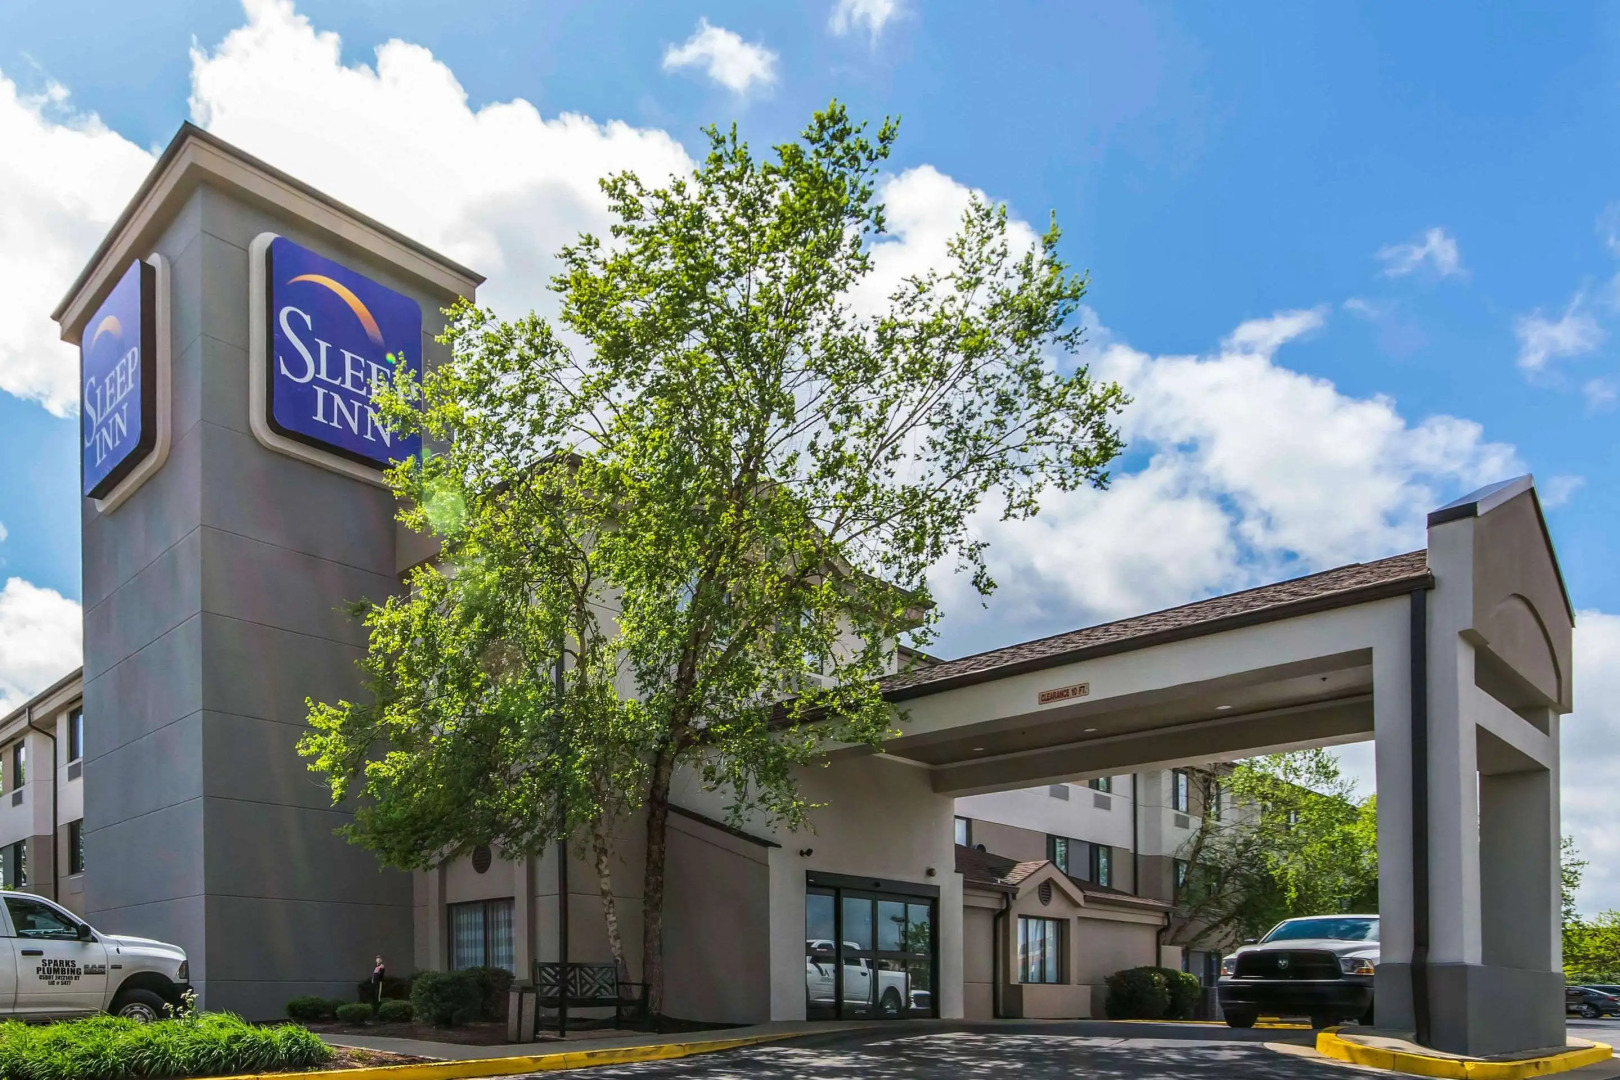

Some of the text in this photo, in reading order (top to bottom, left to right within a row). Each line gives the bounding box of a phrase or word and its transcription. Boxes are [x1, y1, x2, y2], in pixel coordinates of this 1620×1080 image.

[279, 305, 420, 402] SLEE
[84, 346, 138, 449] SLEEP
[312, 386, 399, 448] INN
[95, 402, 128, 467] INN
[1041, 689, 1069, 702] CLEARANCE
[1072, 687, 1077, 696] 10
[36, 967, 82, 975] PLUMBING
[42, 959, 76, 967] SPARKS
